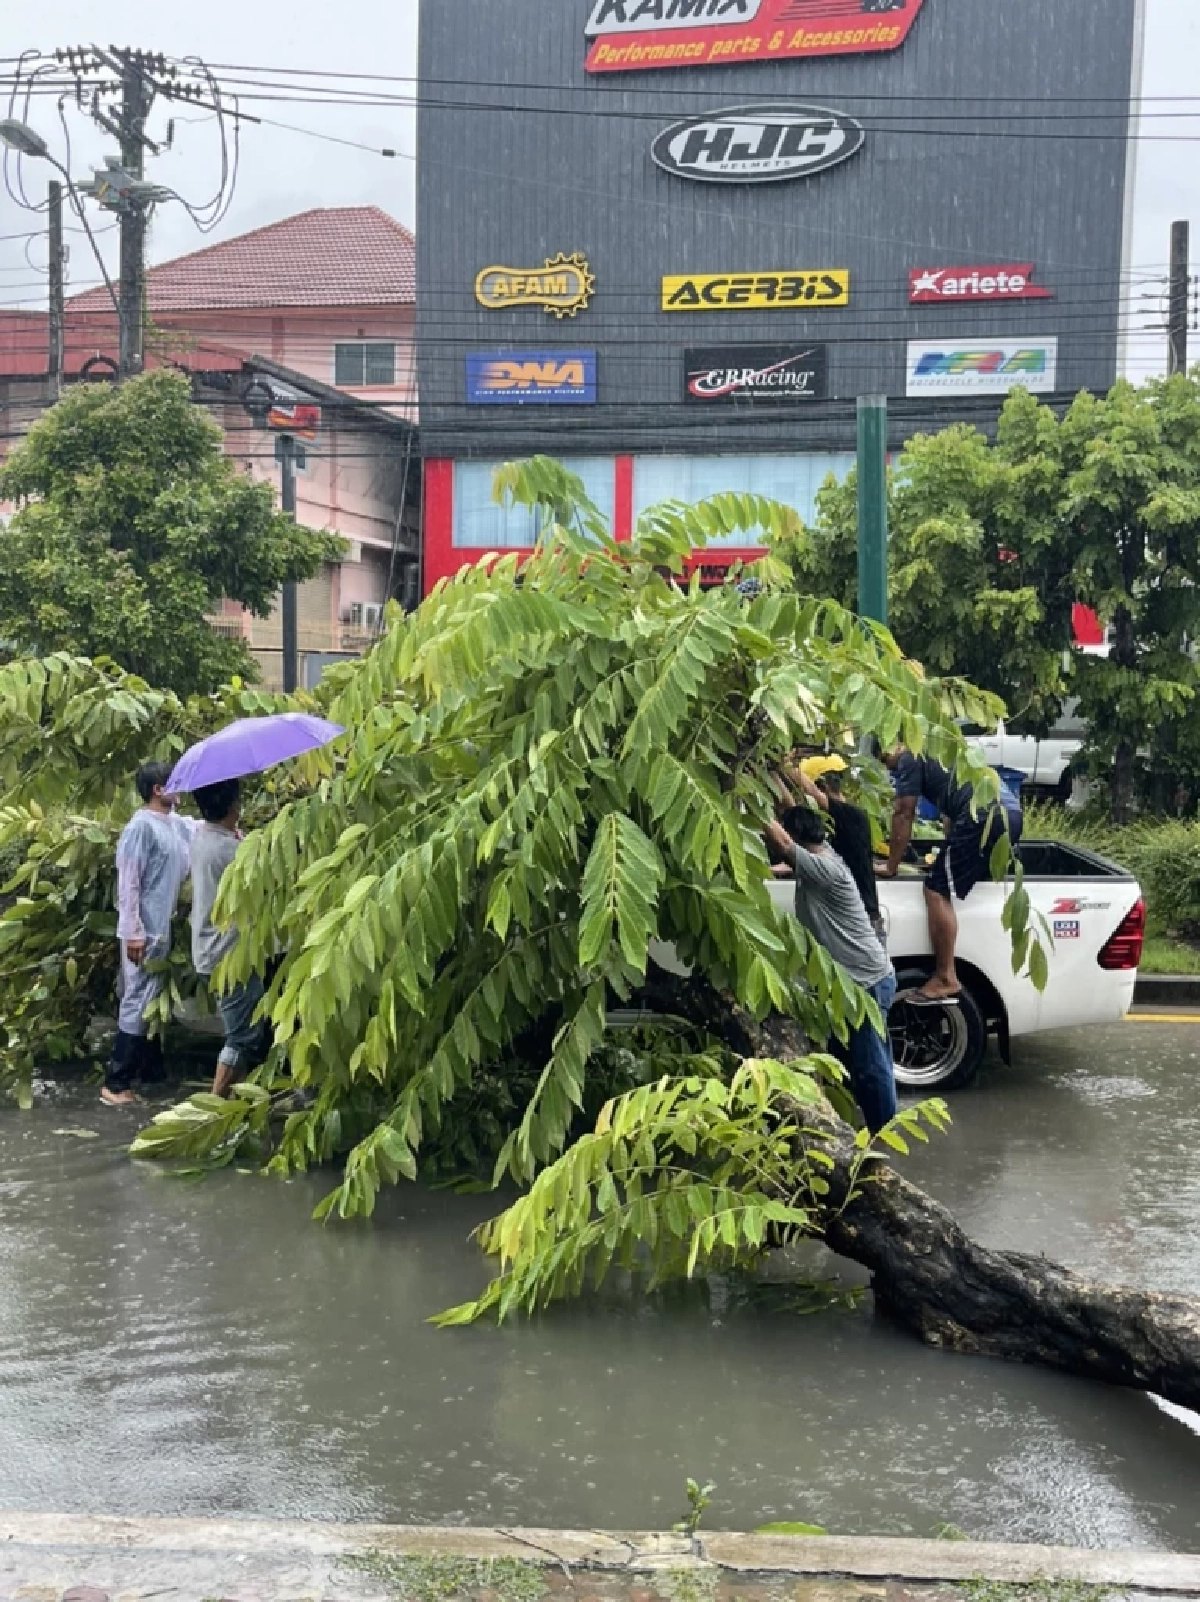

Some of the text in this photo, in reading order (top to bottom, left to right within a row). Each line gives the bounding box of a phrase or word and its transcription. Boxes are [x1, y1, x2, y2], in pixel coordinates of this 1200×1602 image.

[594, 21, 901, 65] Performance parts & Accessories
[679, 124, 833, 163] HJC
[492, 274, 568, 298] AFAM
[941, 270, 1027, 296] ariete
[480, 359, 585, 389] DNA
